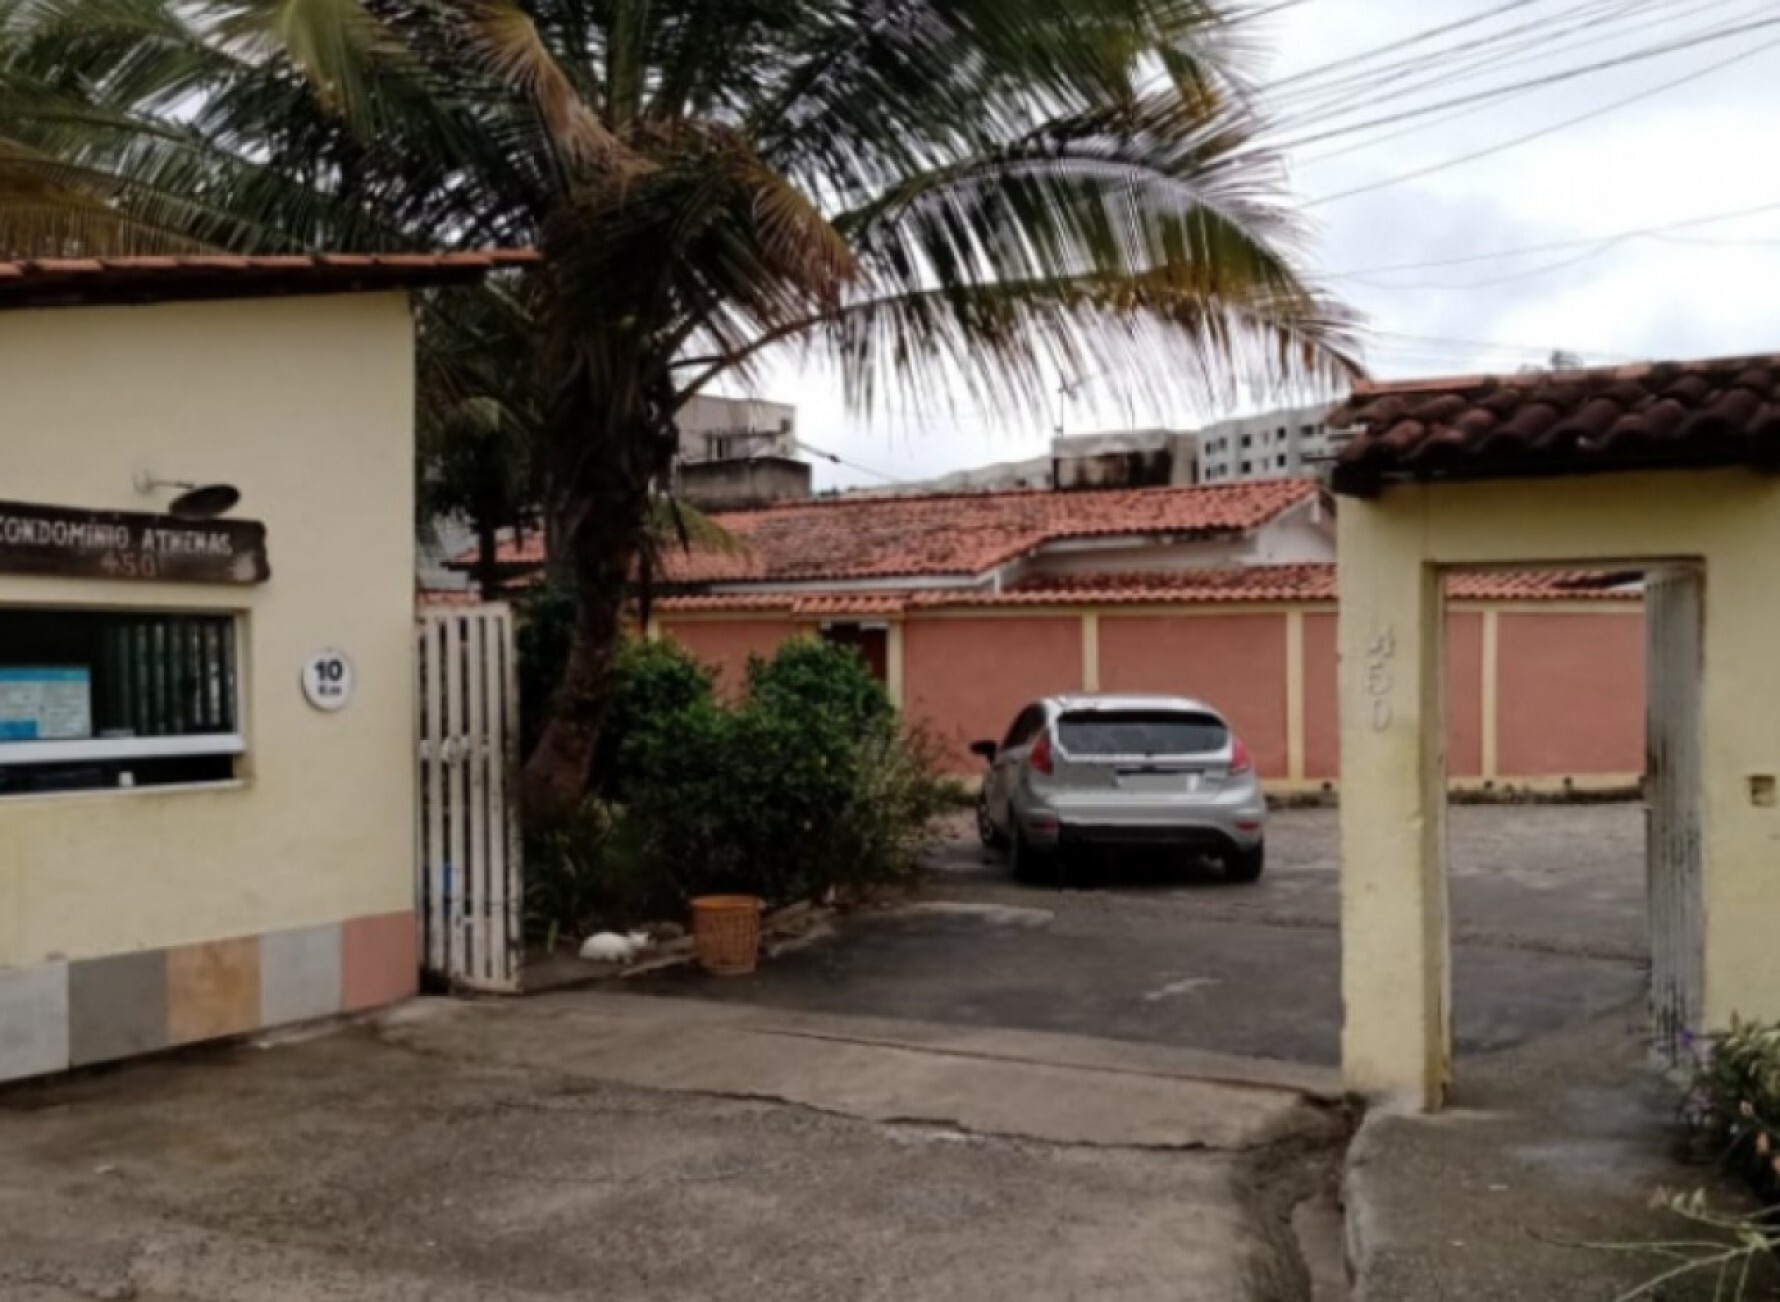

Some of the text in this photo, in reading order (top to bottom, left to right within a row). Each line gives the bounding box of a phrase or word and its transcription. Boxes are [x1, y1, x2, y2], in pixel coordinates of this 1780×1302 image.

[141, 528, 233, 556] ATHENAS
[100, 551, 157, 577] 450
[314, 659, 343, 682] 10
